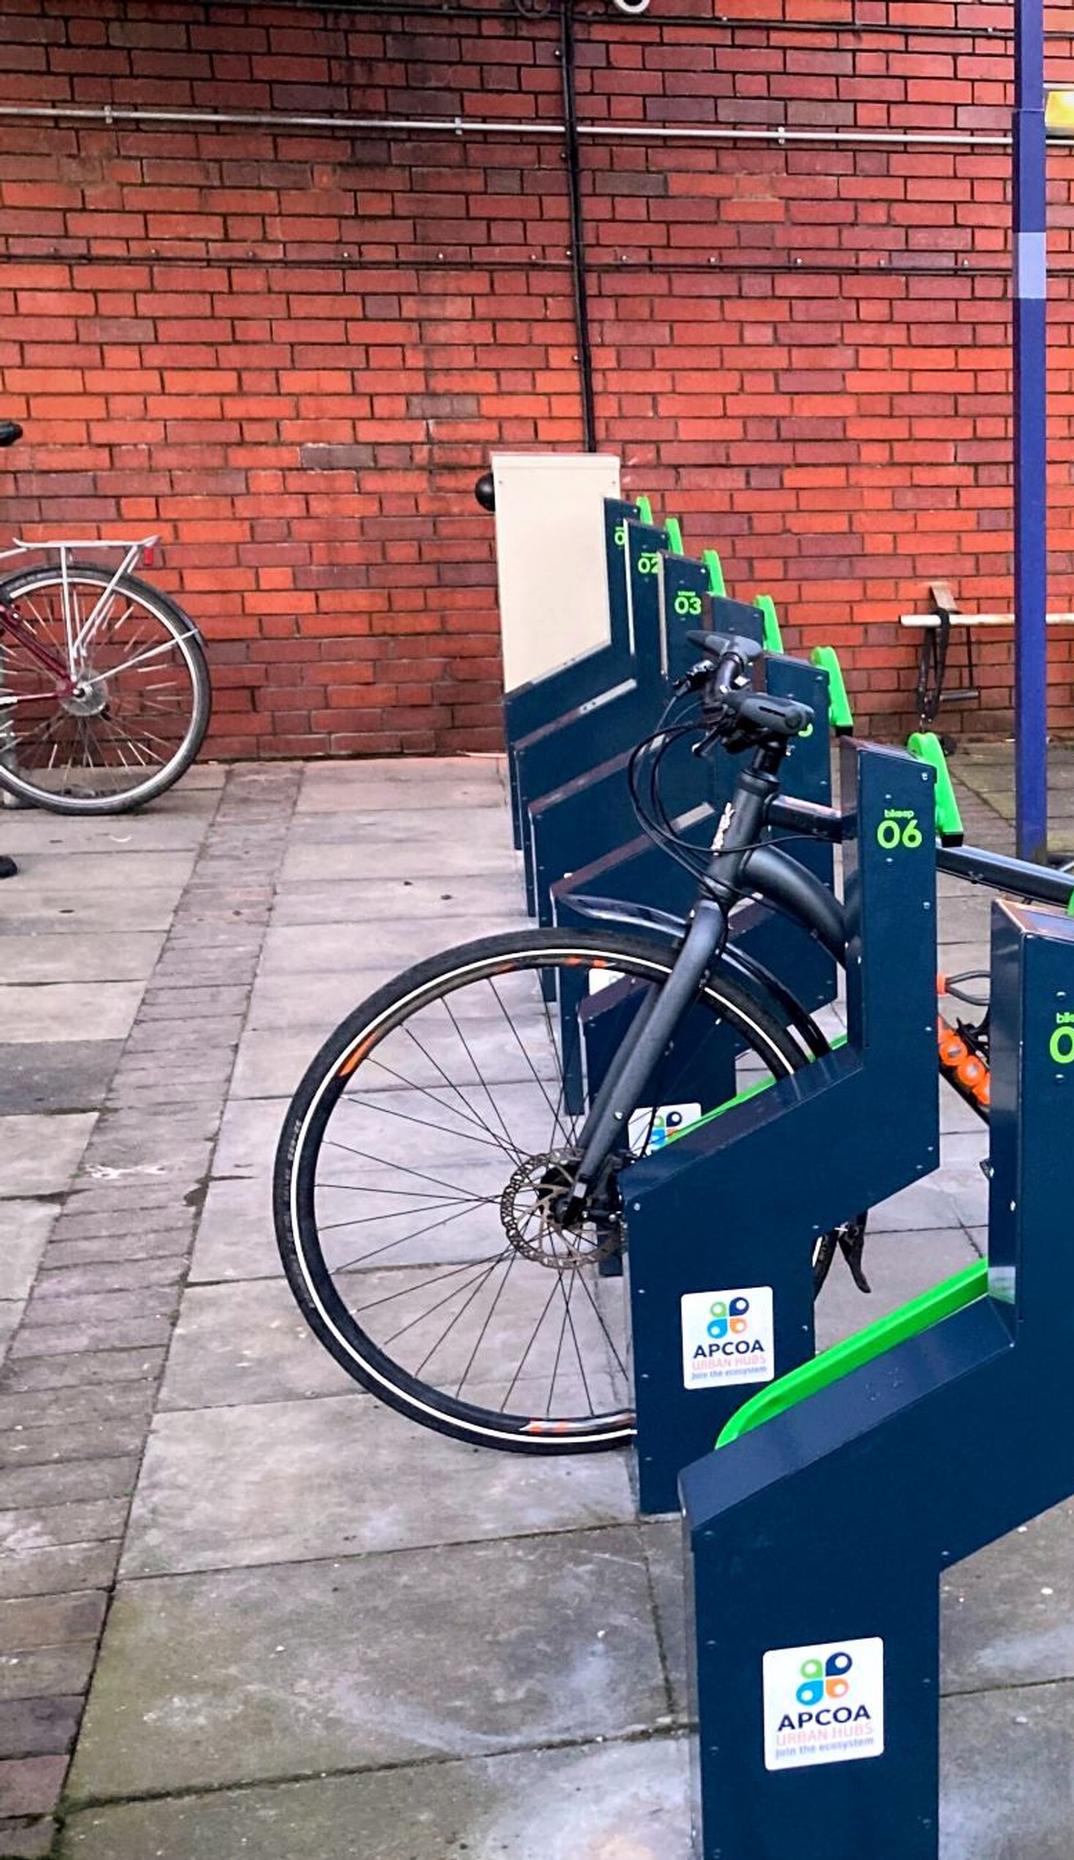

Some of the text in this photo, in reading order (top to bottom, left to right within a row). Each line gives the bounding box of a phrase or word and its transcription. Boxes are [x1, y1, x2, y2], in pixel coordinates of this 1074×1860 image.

[674, 597, 702, 615] 03
[877, 819, 922, 849] 06
[693, 1339, 765, 1359] APCOA
[777, 1704, 872, 1732] APCOA
[776, 1721, 875, 1747] URBAN HUBS
[798, 1744, 817, 1755] the
[818, 1736, 875, 1752] ecosystem
